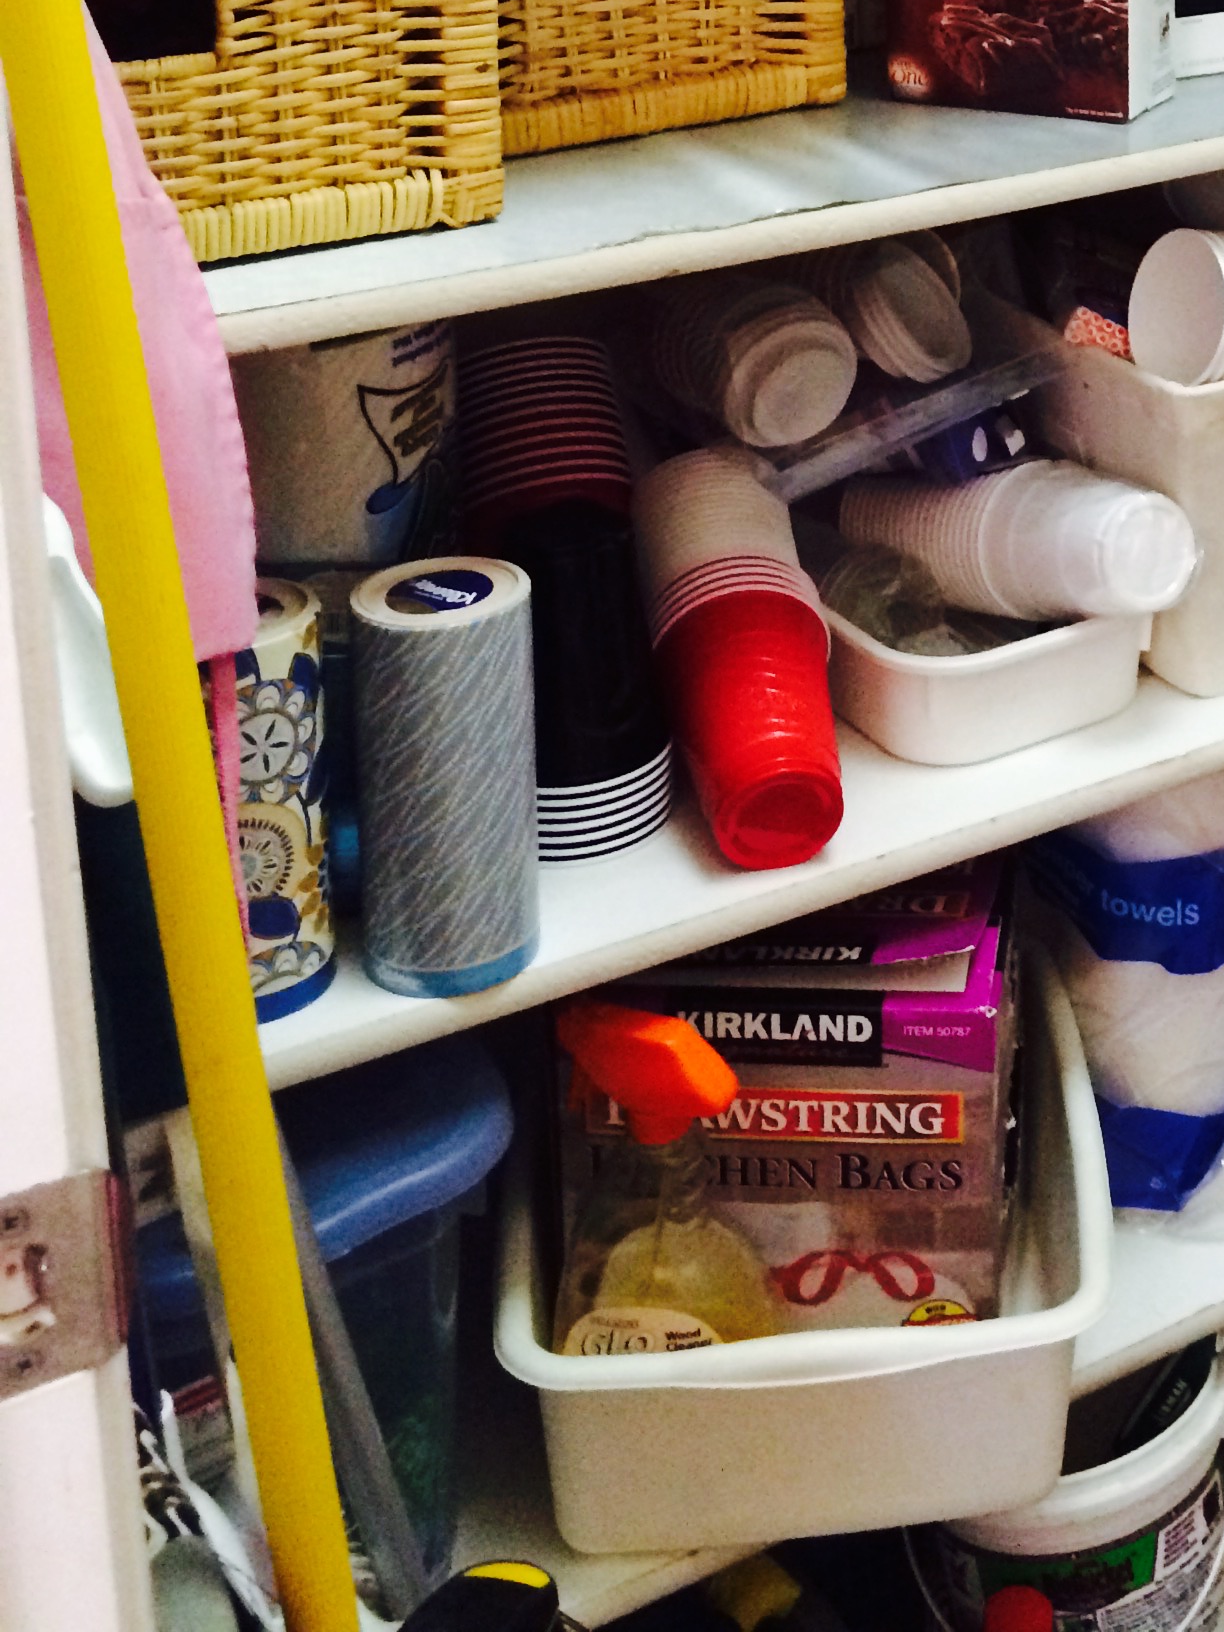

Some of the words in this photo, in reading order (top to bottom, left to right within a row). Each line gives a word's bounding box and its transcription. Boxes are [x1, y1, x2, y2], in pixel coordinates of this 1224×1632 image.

[1101, 888, 1200, 927] towels
[676, 1010, 873, 1043] KIRKLAND
[903, 1026, 934, 1037] ITEM
[606, 1096, 946, 1136] WSTRING
[836, 1152, 964, 1193] BAGS
[664, 1327, 702, 1342] Wood
[665, 1337, 713, 1353] Cleaner
